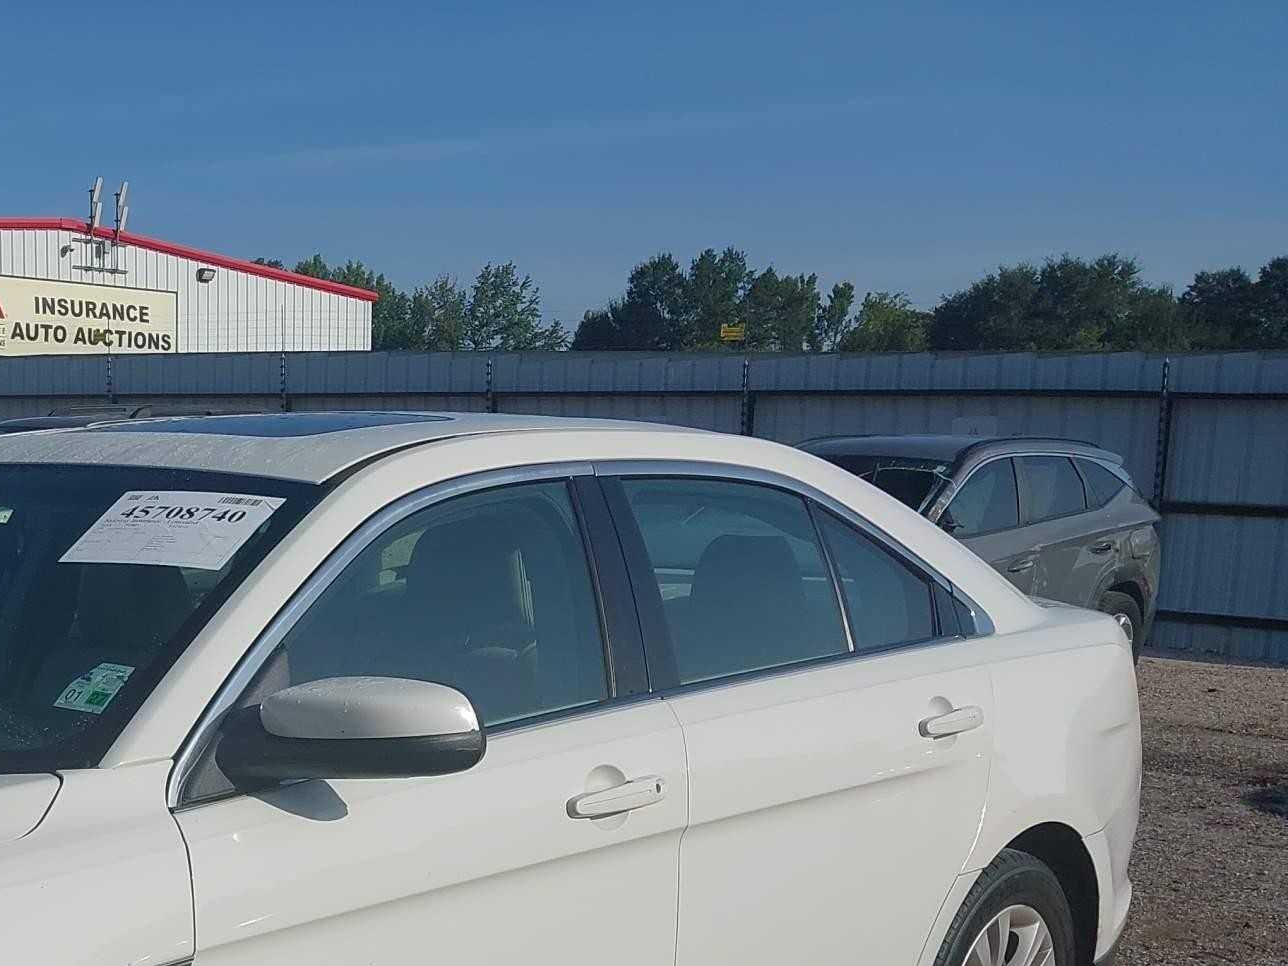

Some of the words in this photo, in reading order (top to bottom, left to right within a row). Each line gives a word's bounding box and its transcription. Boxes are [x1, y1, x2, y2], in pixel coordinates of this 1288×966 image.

[34, 297, 150, 323] INSURANCE
[10, 322, 67, 344] AUTO
[73, 327, 171, 351] AUCTIONS
[120, 505, 247, 524] 45708740
[64, 688, 84, 702] 01
